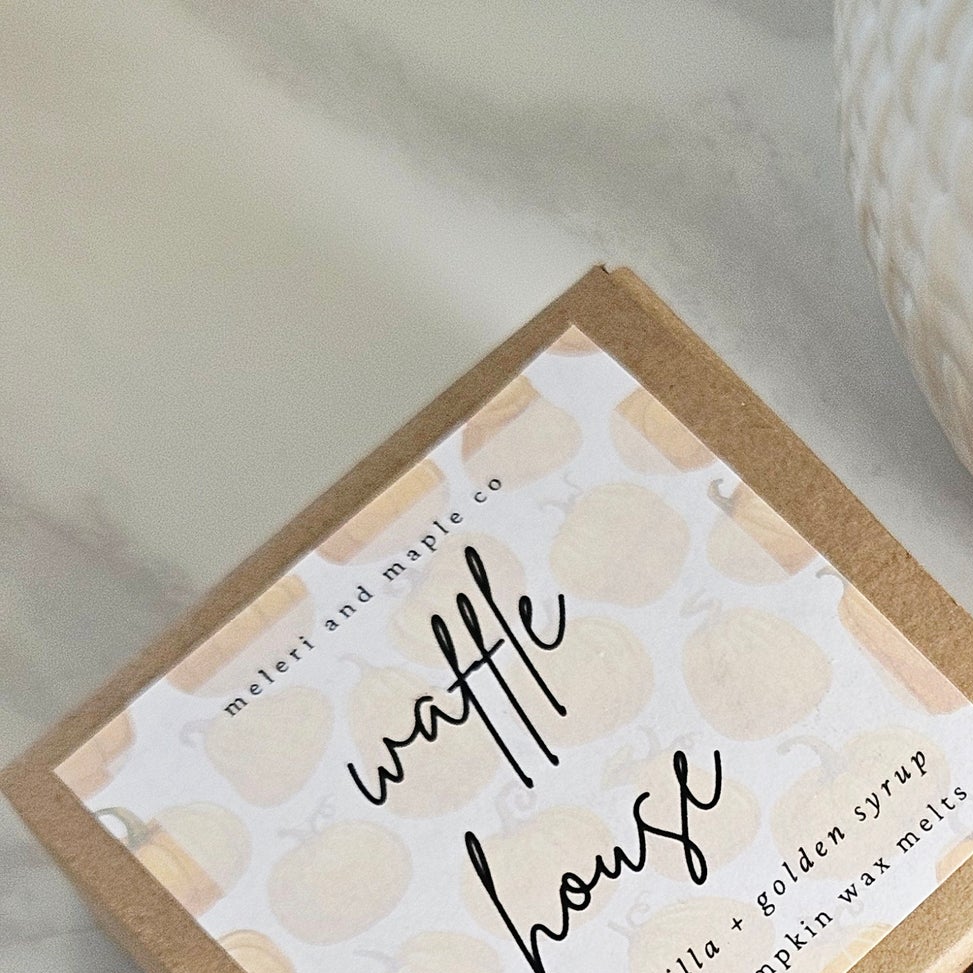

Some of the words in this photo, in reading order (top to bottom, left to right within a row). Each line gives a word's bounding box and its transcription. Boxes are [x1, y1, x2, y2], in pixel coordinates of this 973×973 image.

[224, 636, 315, 716] meleri
[324, 586, 374, 632] and
[382, 512, 464, 582] maple
[473, 478, 502, 503] co
[347, 546, 567, 806] waffle
[731, 917, 743, 931] +
[757, 826, 845, 917] golden
[854, 750, 926, 822] syrup
[837, 857, 891, 903] wax
[896, 786, 968, 853] melts
